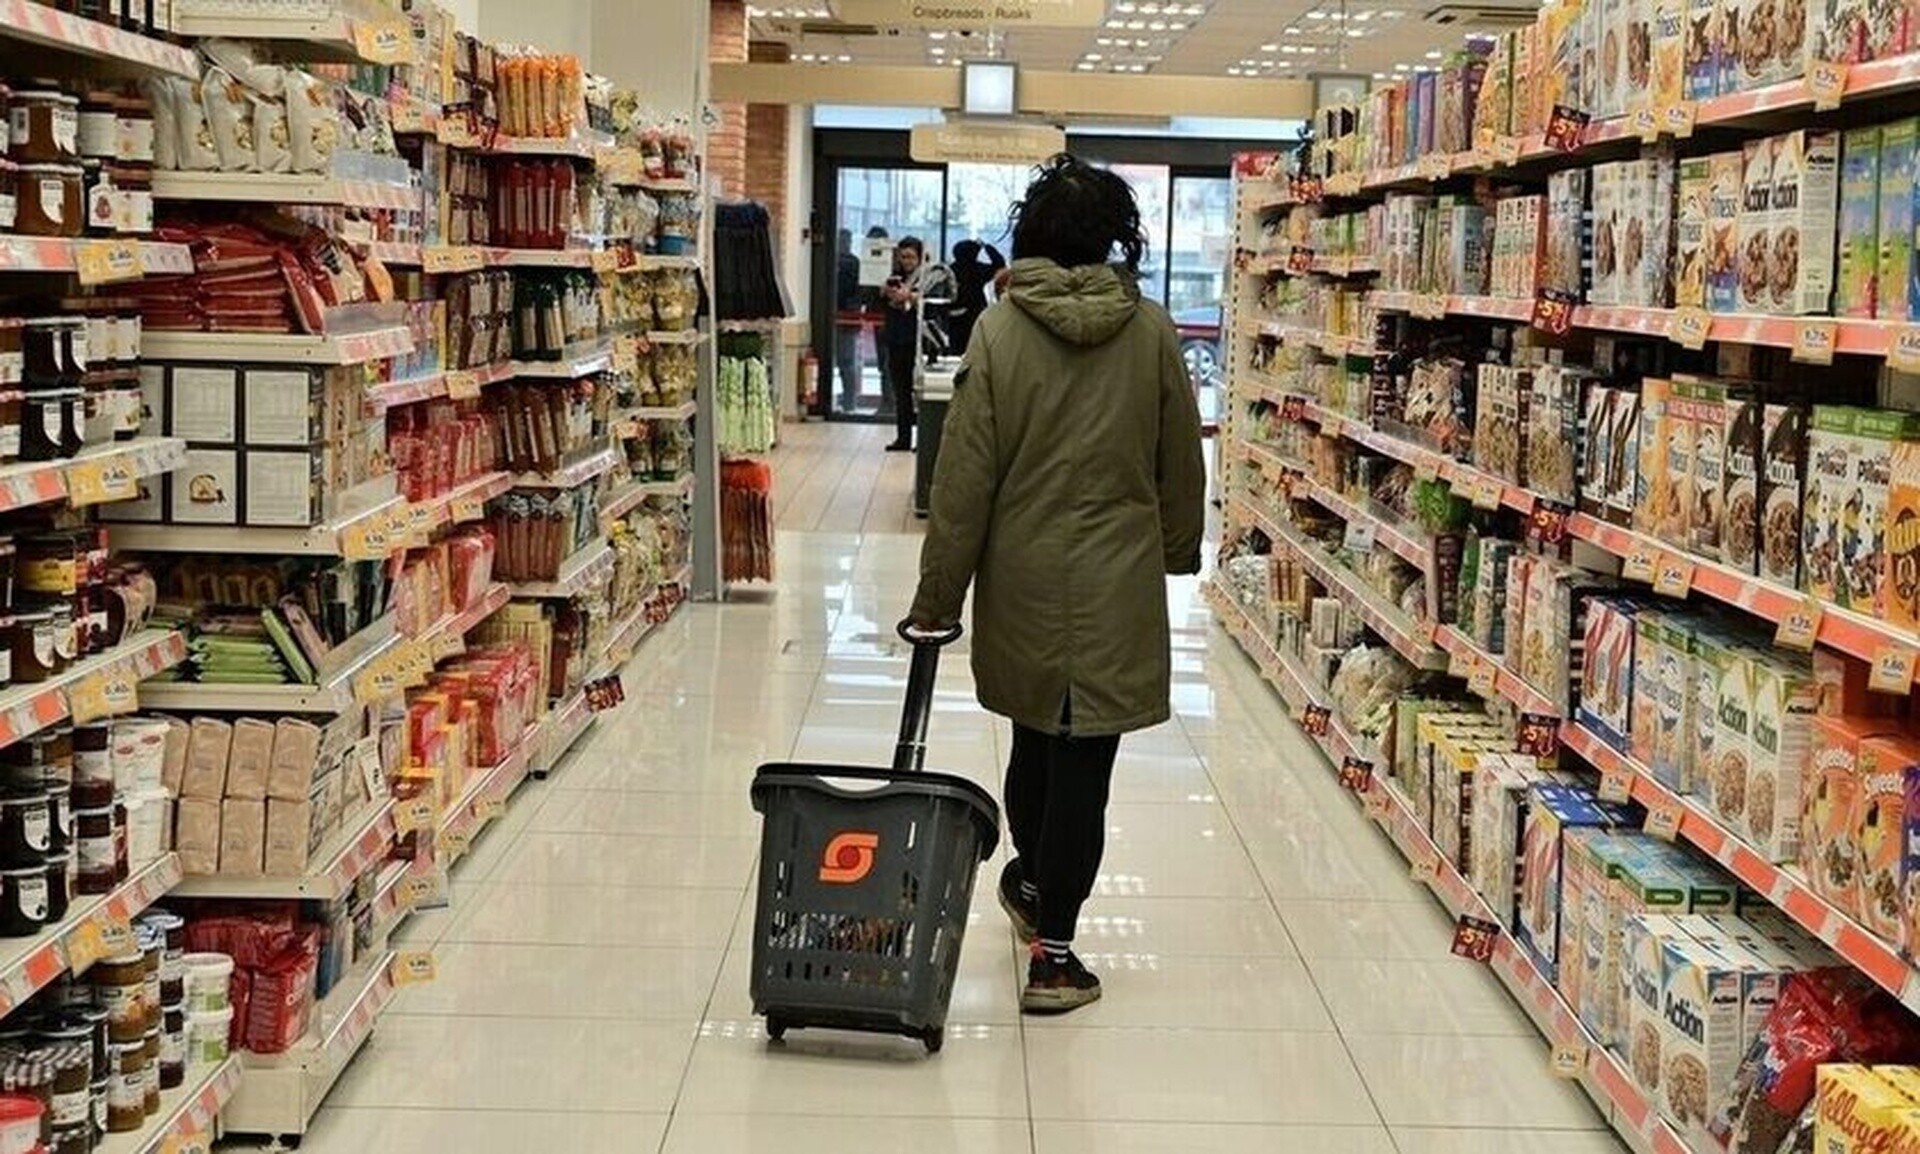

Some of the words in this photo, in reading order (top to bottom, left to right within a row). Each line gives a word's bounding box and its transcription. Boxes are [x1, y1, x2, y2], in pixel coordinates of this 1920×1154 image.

[913, 6, 984, 20] Crispbreads
[995, 6, 1032, 20] Rusks
[1807, 155, 1835, 165] Action
[1663, 989, 1704, 1045] Action
